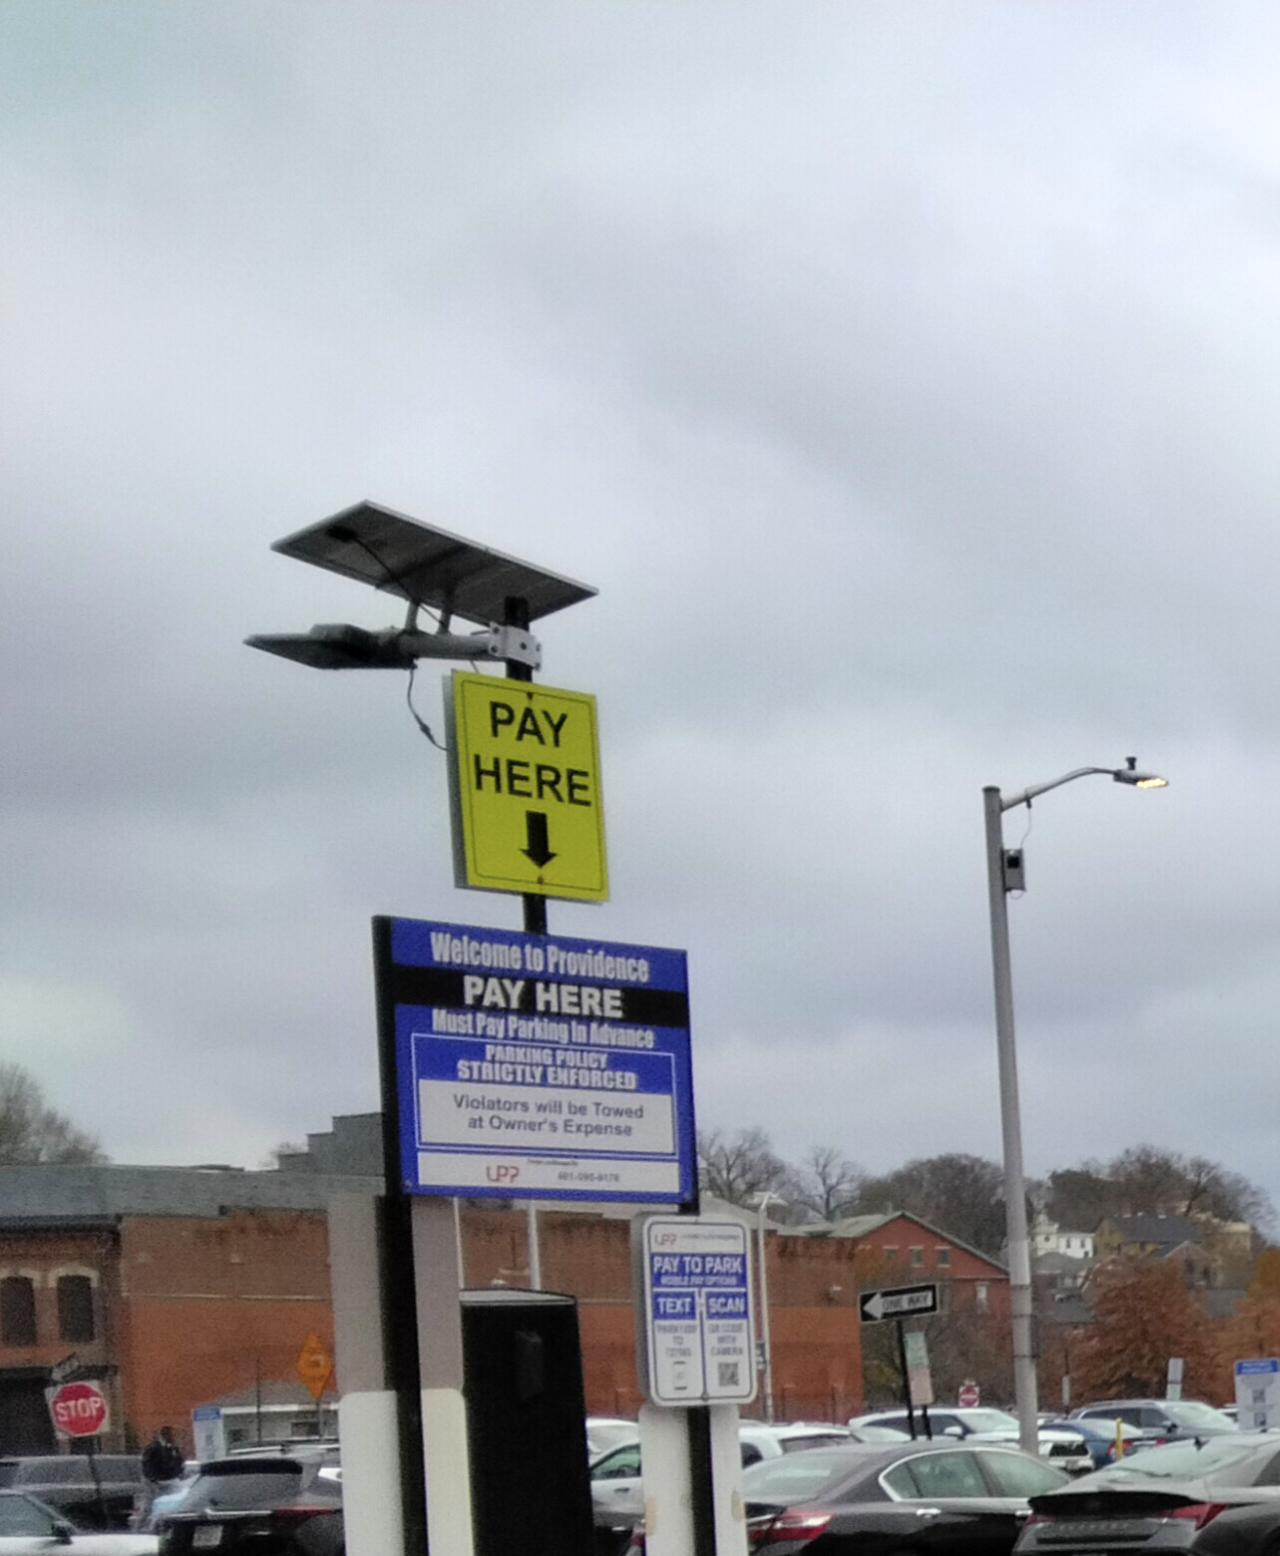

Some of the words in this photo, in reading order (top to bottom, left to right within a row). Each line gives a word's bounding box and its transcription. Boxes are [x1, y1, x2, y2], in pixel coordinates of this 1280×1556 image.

[489, 699, 569, 750] PAY
[473, 752, 593, 808] HERE
[430, 932, 523, 970] Welcome
[525, 943, 544, 972] to
[547, 945, 650, 983] Providence
[463, 974, 525, 1010] PAY
[535, 981, 623, 1019] HERE
[432, 1008, 474, 1035] Must
[476, 1013, 505, 1039] Pay
[508, 1016, 570, 1044] Parking
[590, 1021, 655, 1049] Advance
[485, 1043, 554, 1065] PARKING
[556, 1049, 609, 1069] POLICY
[457, 1059, 544, 1084] STRICTLY
[546, 1066, 638, 1090] ENFORCED
[452, 1093, 530, 1113] Violators
[535, 1099, 563, 1115] will
[567, 1101, 588, 1116] be
[593, 1102, 644, 1119] Towed
[468, 1115, 484, 1129] at
[488, 1115, 559, 1133] Owner's
[563, 1119, 633, 1137] Expense
[653, 1256, 680, 1273] PAY
[682, 1256, 703, 1273] TO
[705, 1256, 743, 1274] PARK
[657, 1298, 691, 1314] TEXT
[708, 1296, 745, 1314] SCAN
[55, 1396, 102, 1422] STOP
